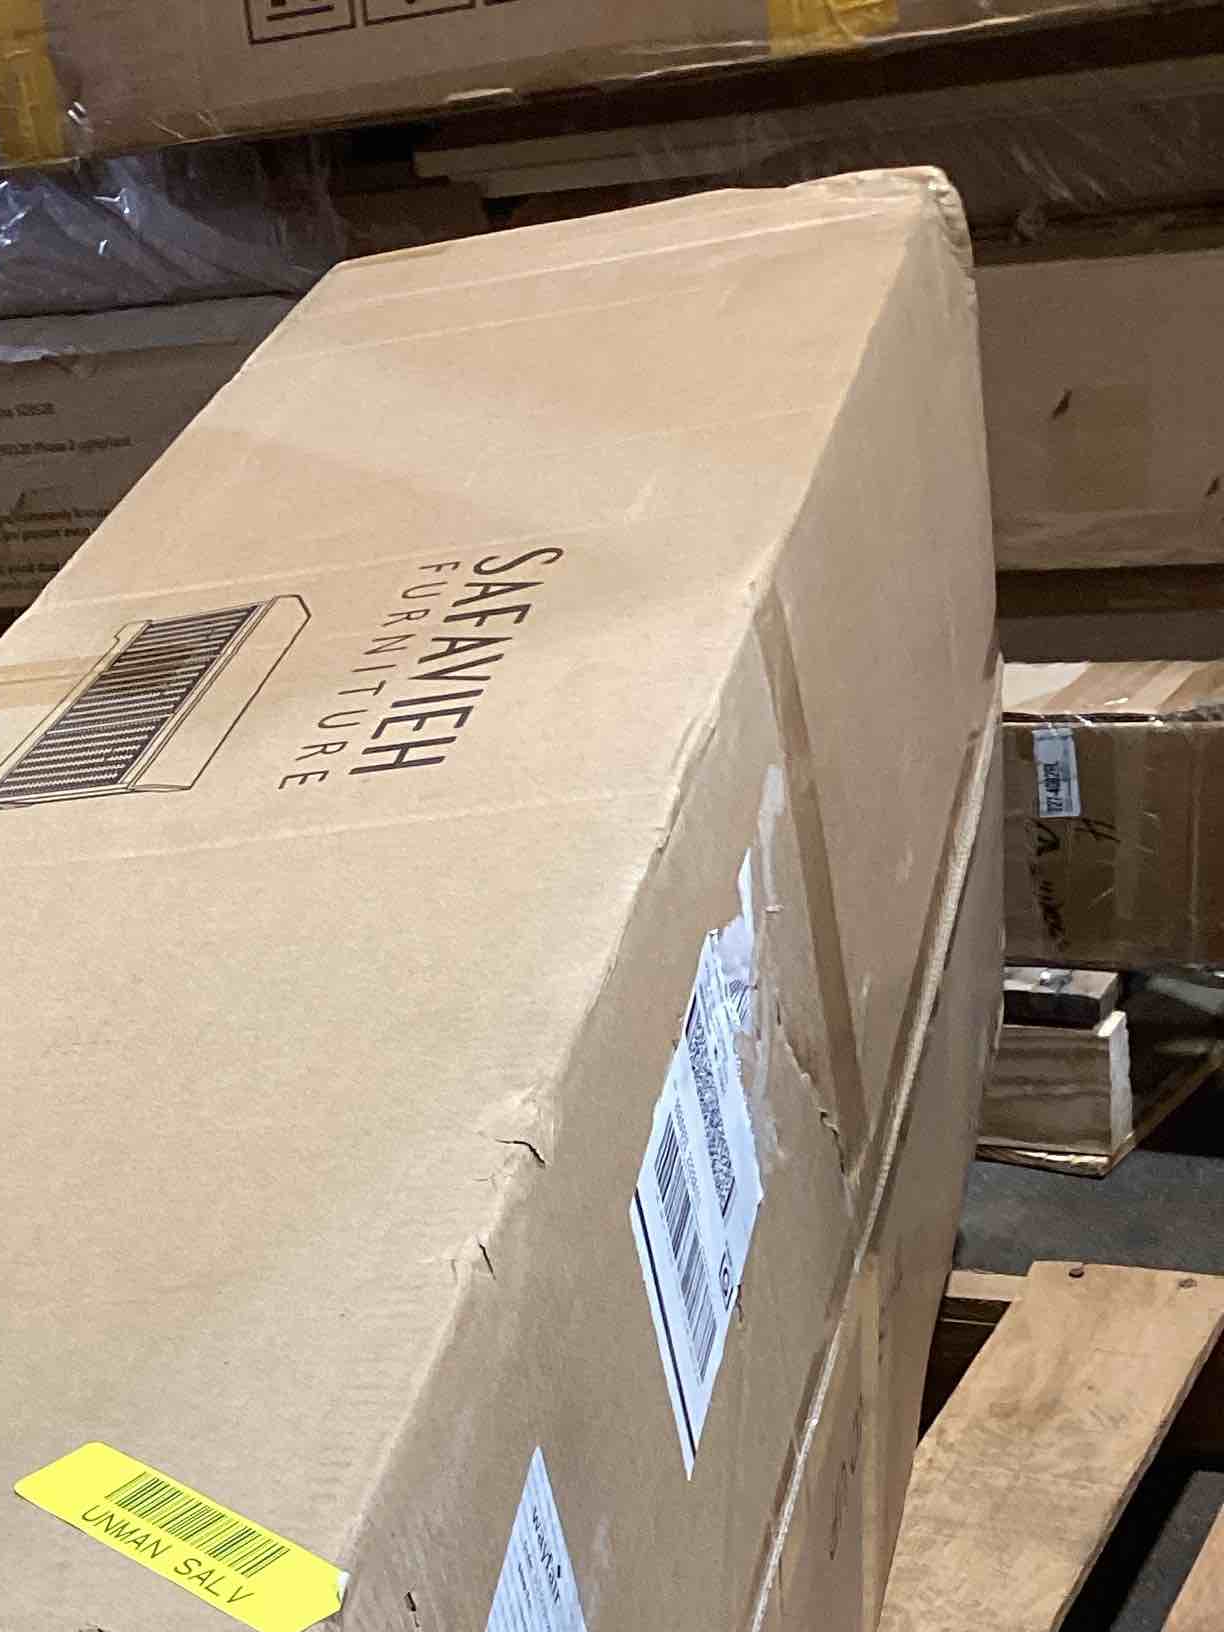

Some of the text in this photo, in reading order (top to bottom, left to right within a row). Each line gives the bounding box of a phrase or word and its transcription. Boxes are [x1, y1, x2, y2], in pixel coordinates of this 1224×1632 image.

[277, 561, 459, 790] FURNITURE
[348, 546, 564, 776] SAFAVIEH
[81, 1503, 258, 1606] UNMAN SALV
